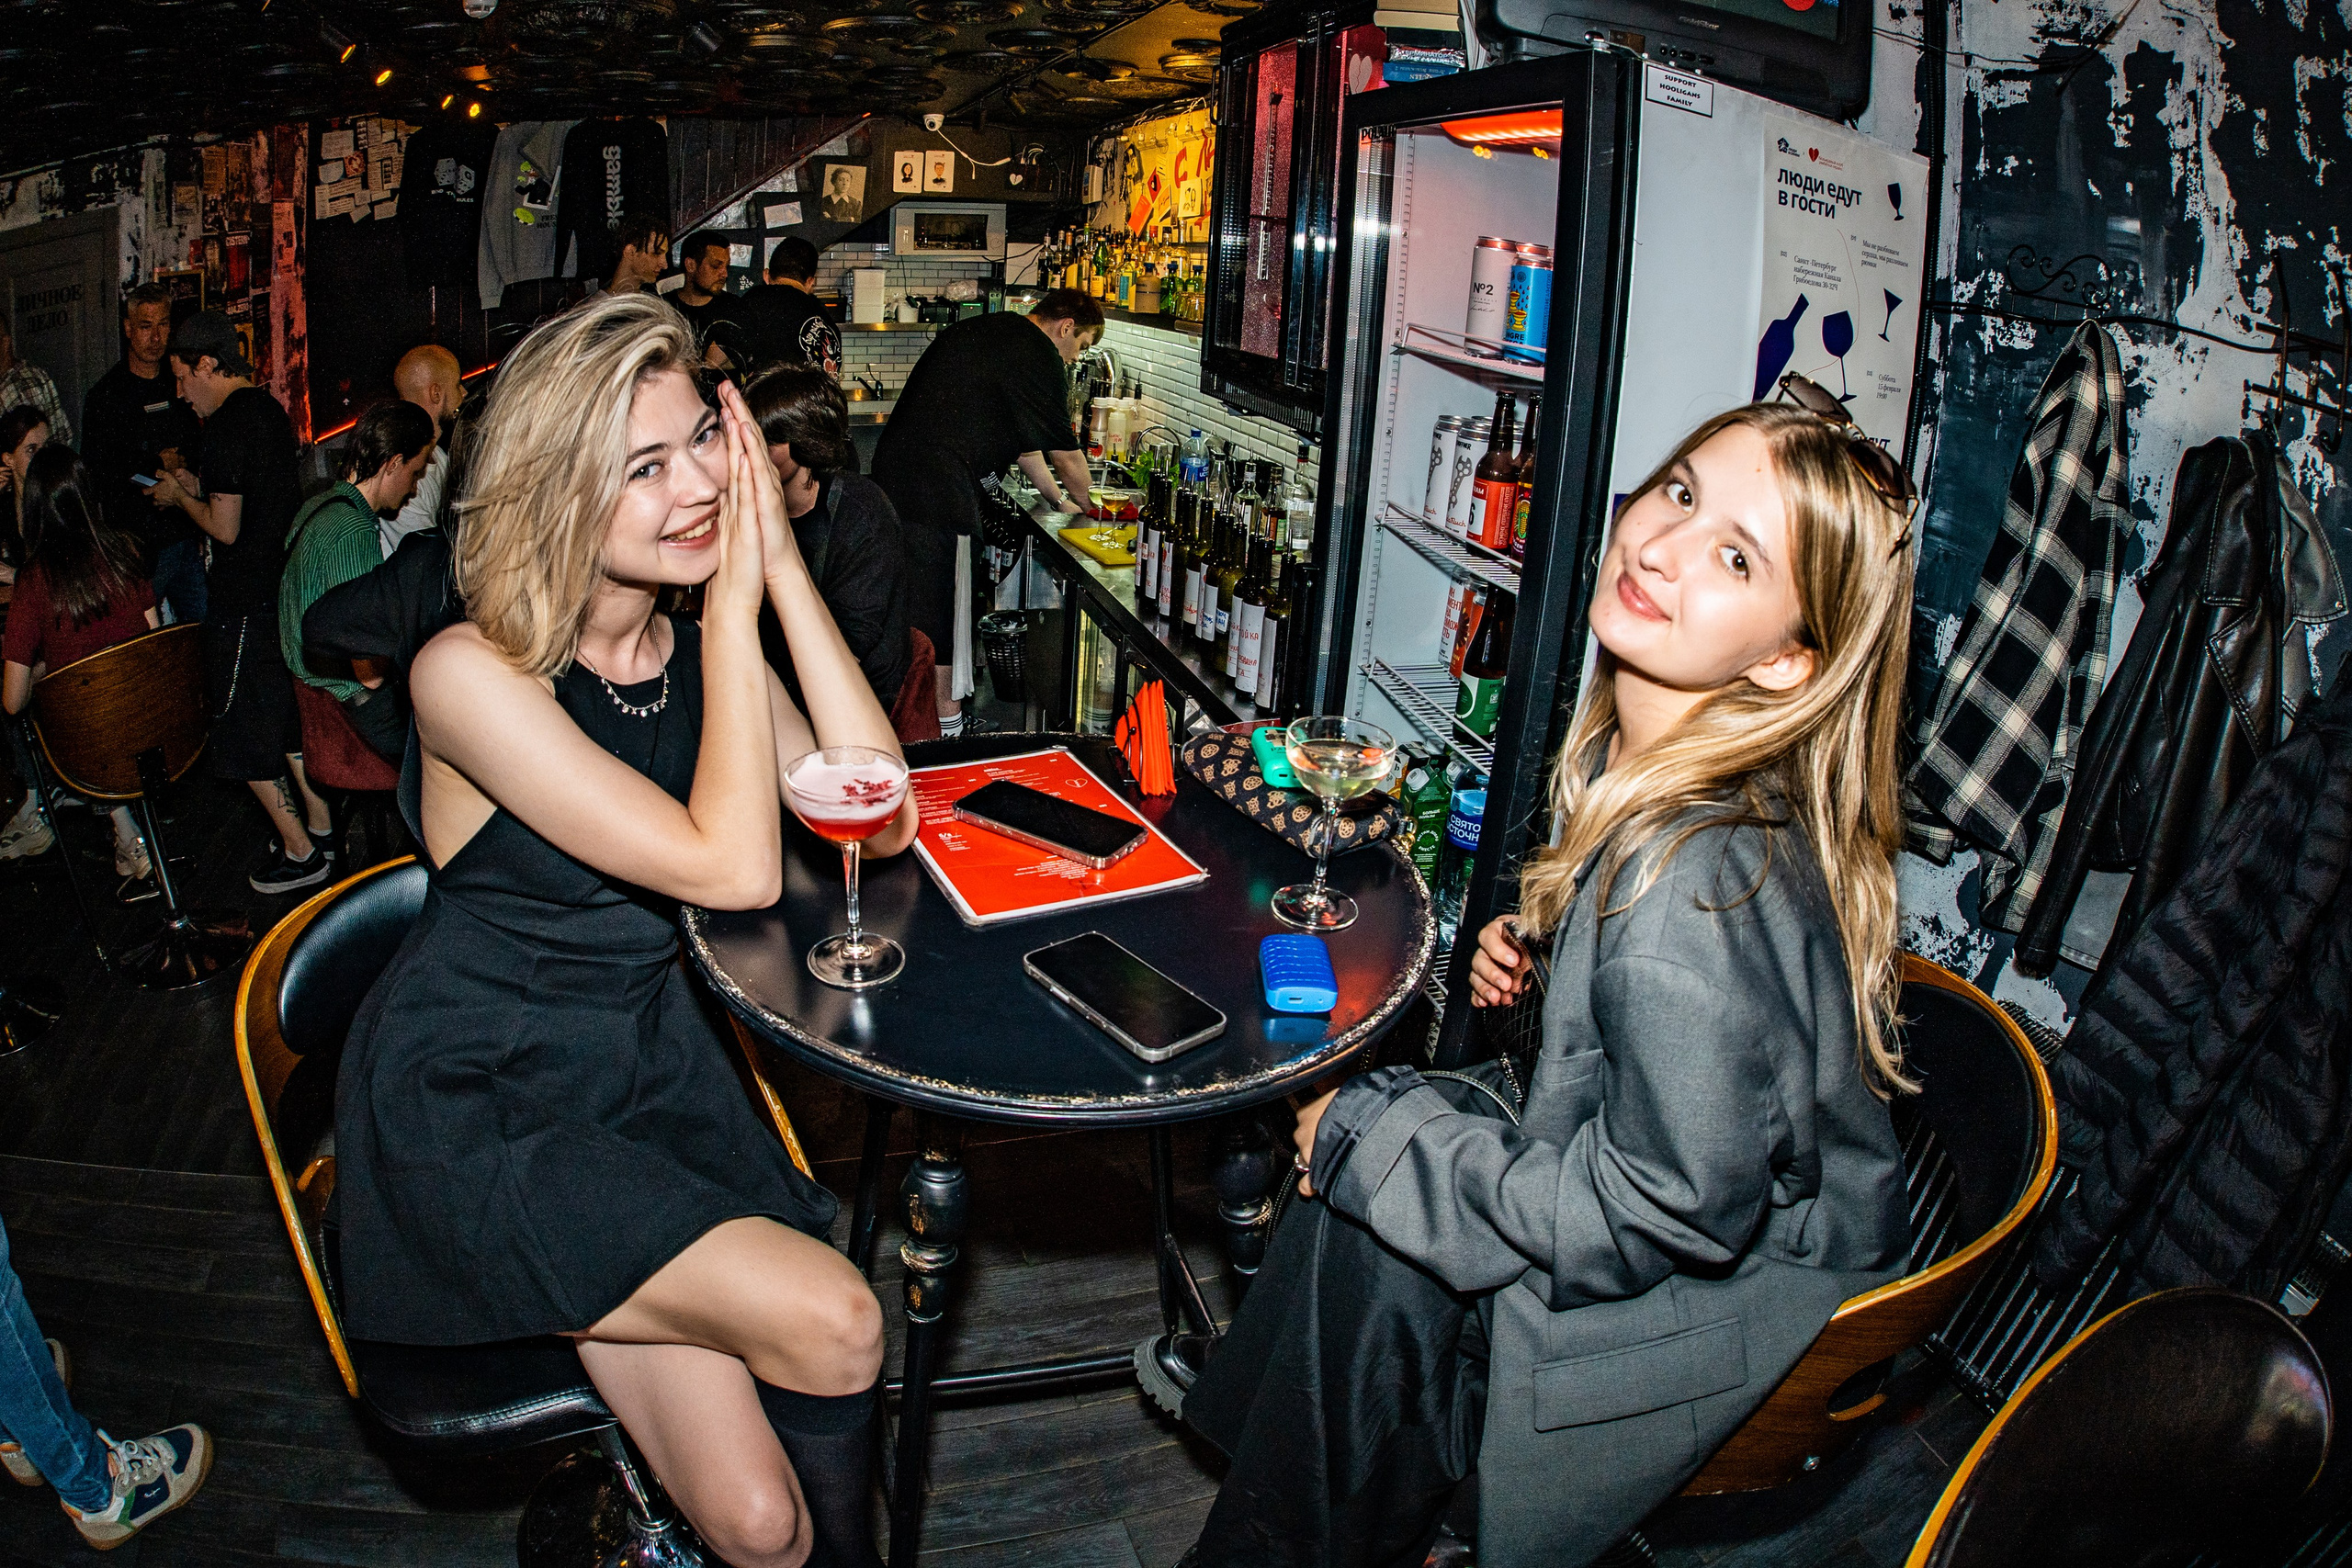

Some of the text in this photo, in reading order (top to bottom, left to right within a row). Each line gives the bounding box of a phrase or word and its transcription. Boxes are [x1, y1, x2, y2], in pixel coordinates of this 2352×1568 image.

[1679, 16, 1720, 30] GoldStar
[1665, 74, 1697, 88] SUPPORT
[1659, 83, 1701, 98] HOOLIGANS
[1667, 96, 1692, 107] FAMILY
